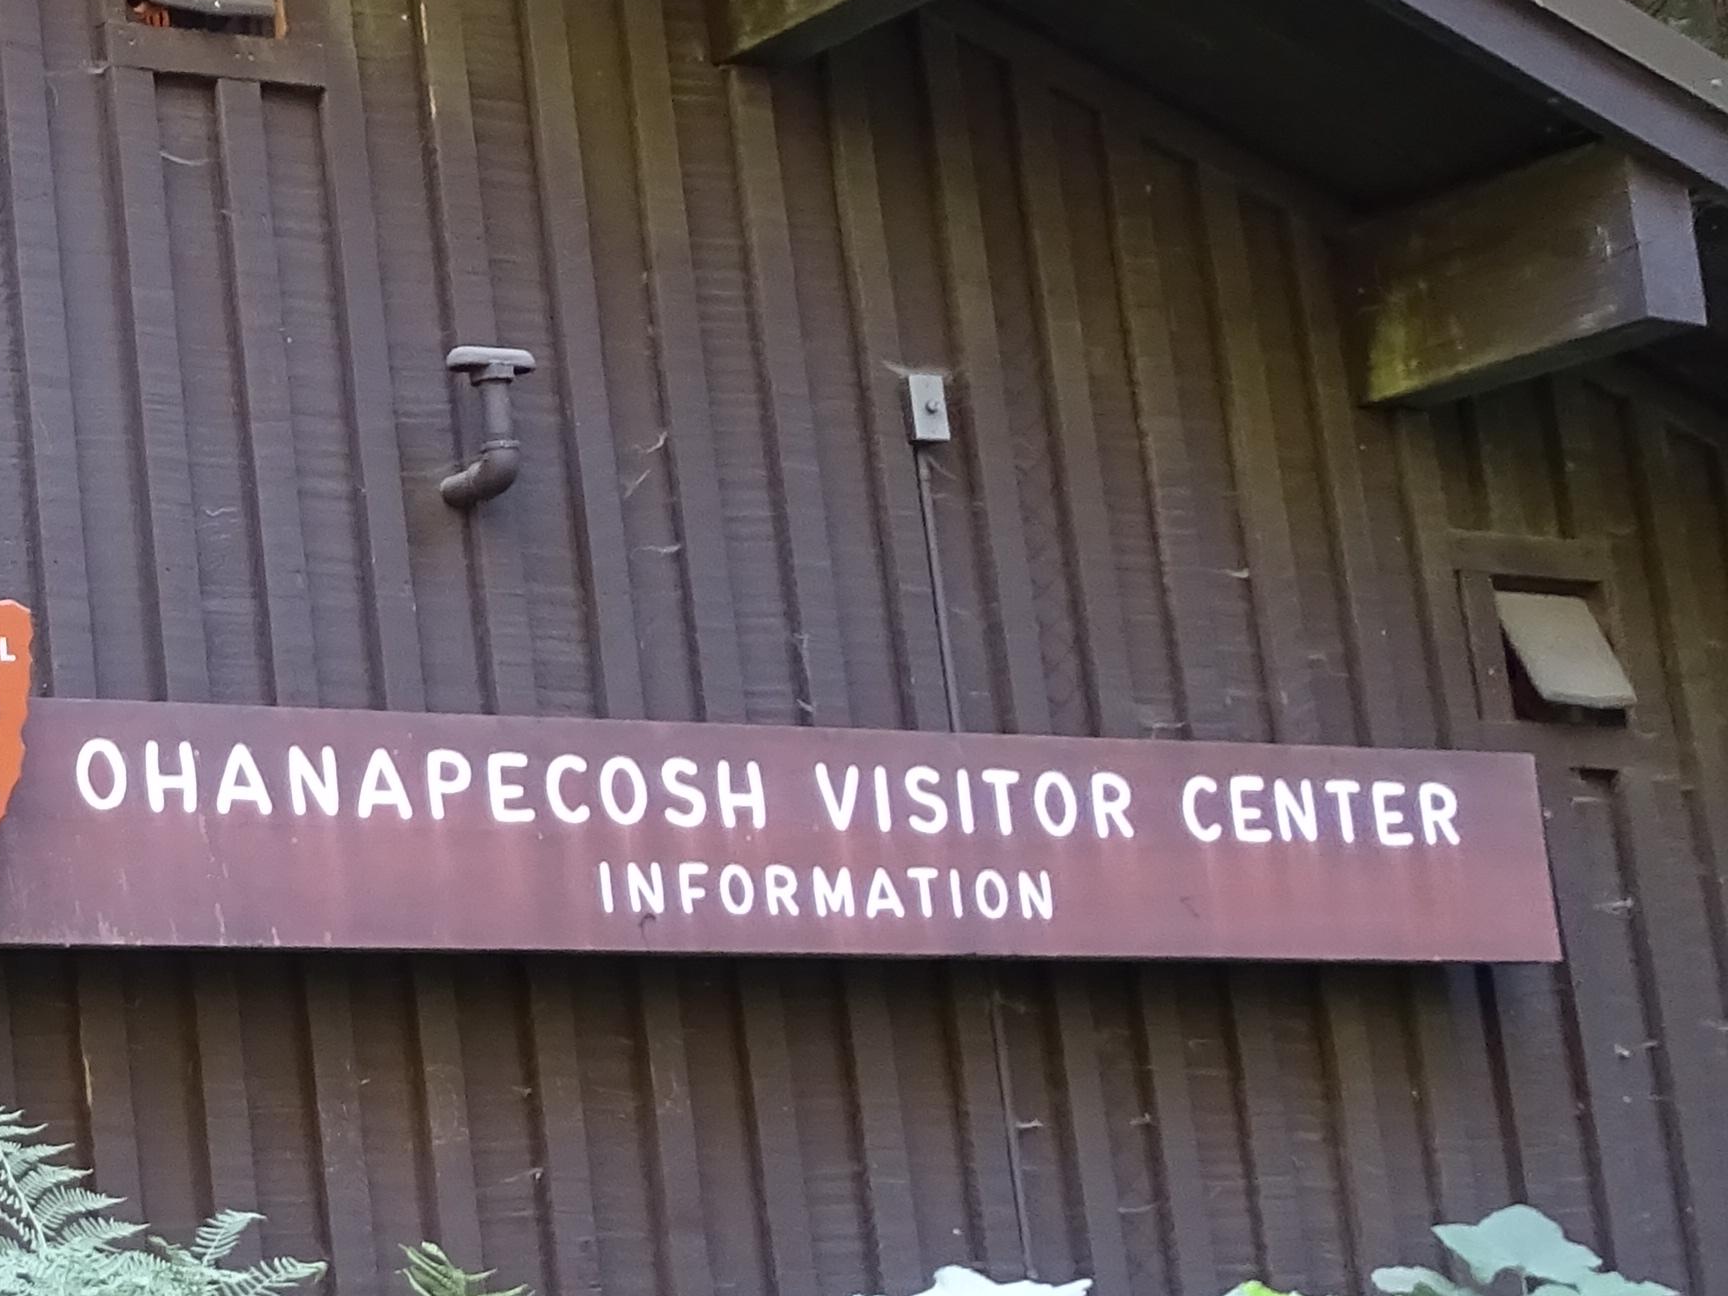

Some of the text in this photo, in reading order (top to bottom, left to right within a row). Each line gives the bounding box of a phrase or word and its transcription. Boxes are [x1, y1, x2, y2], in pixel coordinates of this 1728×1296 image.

[74, 736, 1462, 848] OHANAPECOSH VISITOR CENTER
[598, 860, 1054, 922] INFORMATION
